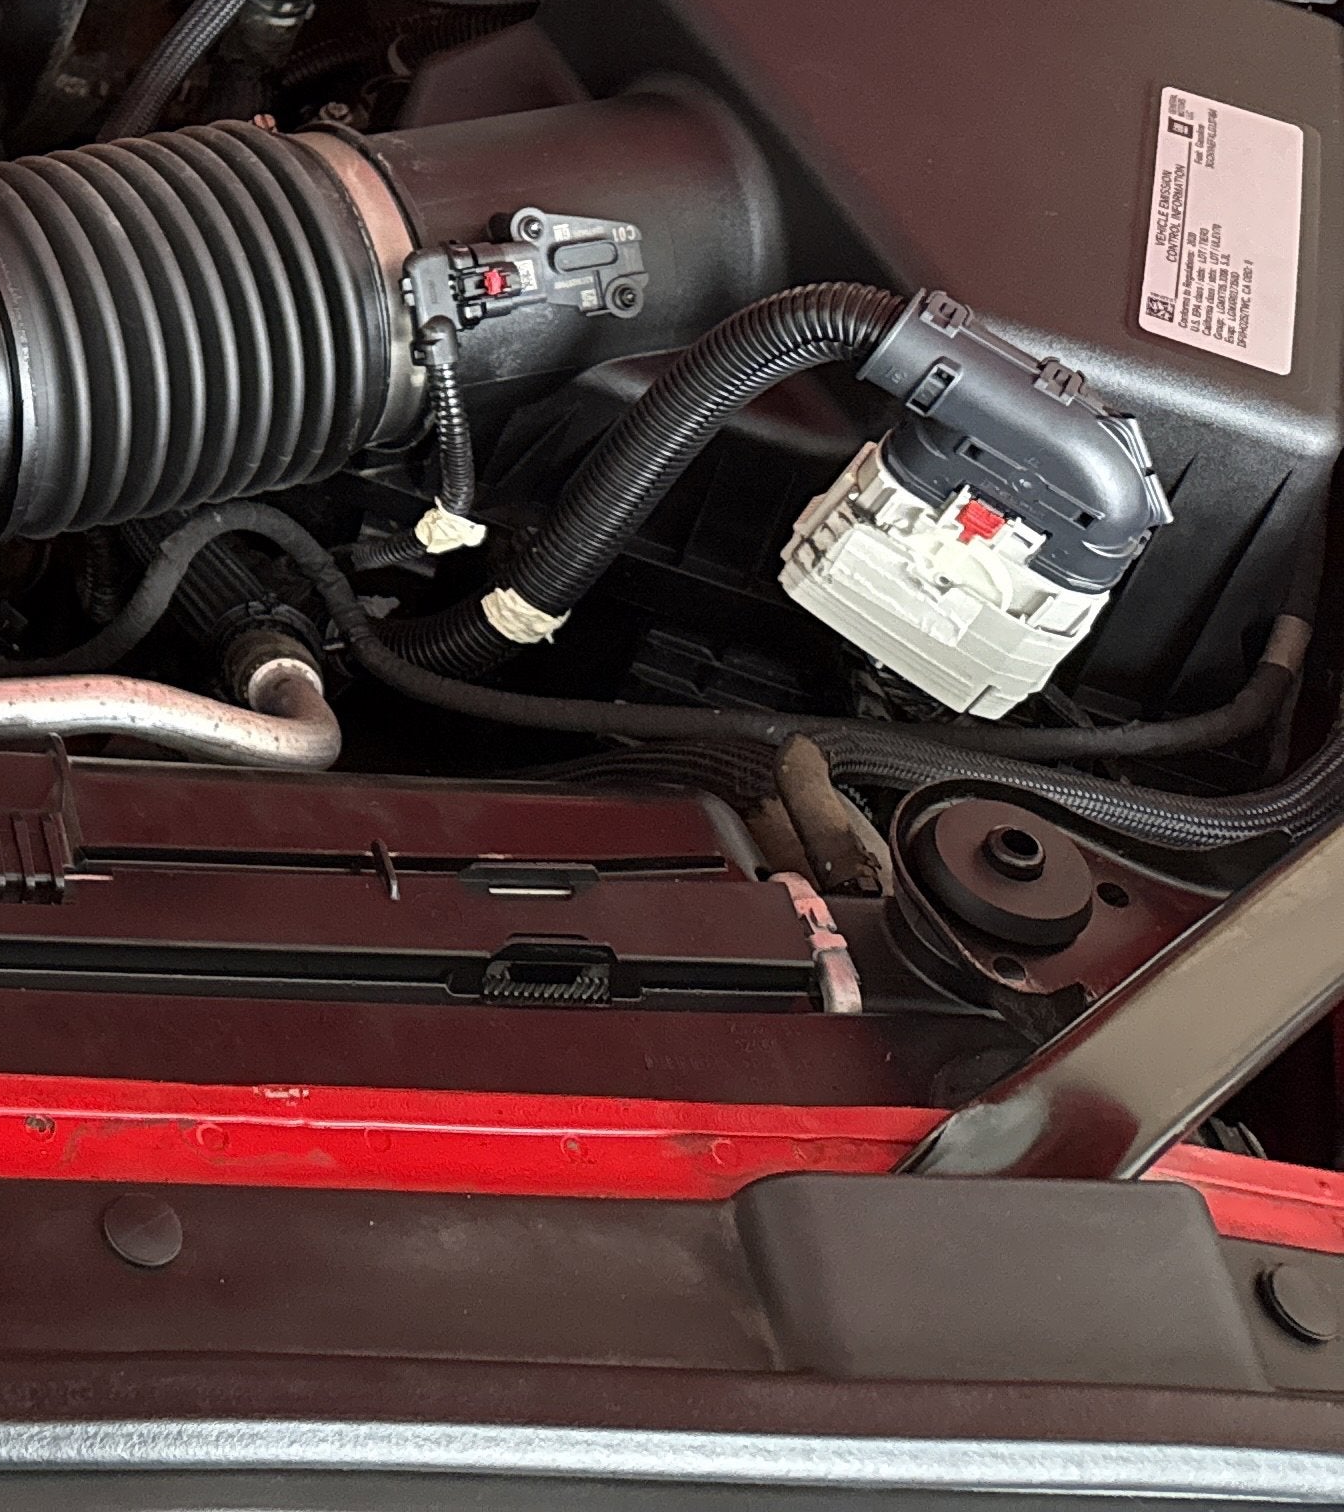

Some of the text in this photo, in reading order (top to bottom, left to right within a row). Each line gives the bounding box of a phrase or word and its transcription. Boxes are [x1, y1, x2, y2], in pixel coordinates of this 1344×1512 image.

[1154, 169, 1173, 246] VEHICLE EMISSION
[1166, 164, 1186, 263] CONTROL INFORMATION
